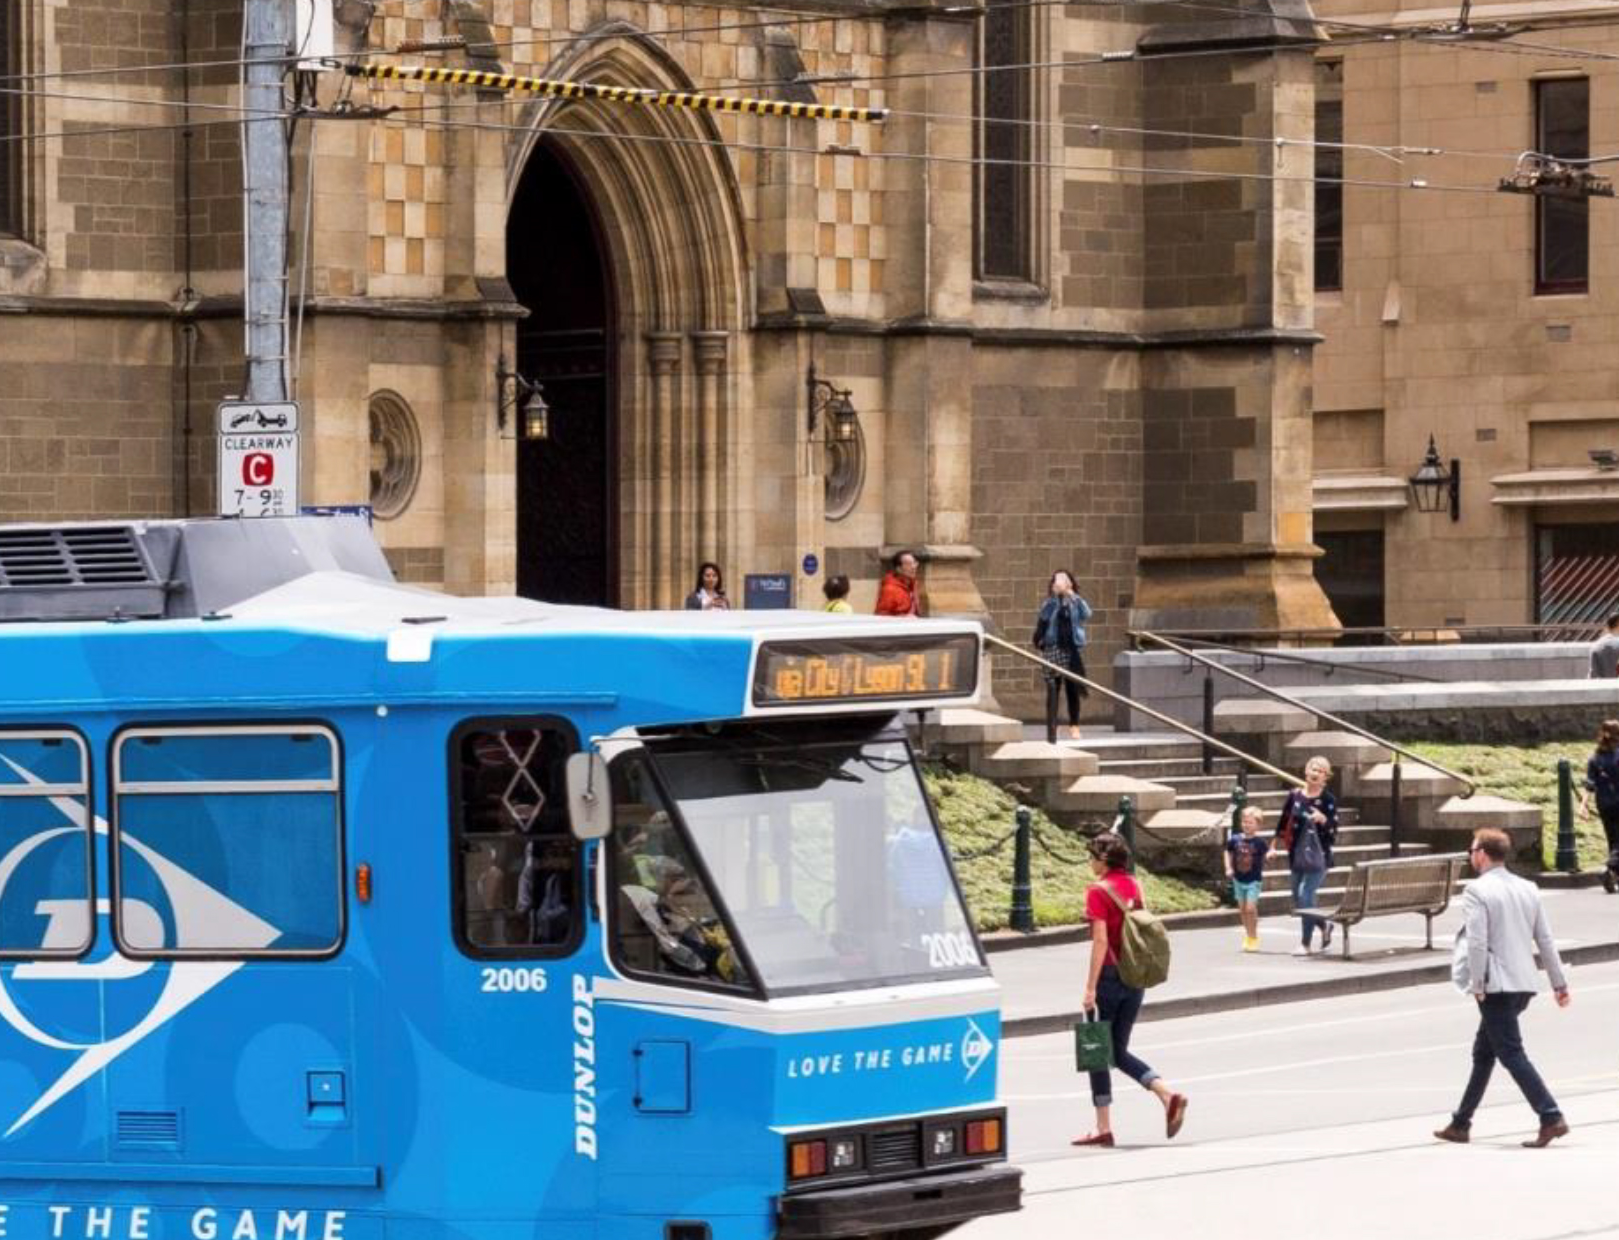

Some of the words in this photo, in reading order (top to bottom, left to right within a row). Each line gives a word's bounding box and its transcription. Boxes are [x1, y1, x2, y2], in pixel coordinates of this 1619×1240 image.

[225, 438, 293, 450] CLEARWAY
[249, 454, 267, 484] C
[481, 967, 548, 993] 2006
[572, 973, 600, 1162] DUNLOP
[788, 1054, 842, 1078] LOVE
[854, 1049, 892, 1071] THE
[901, 1042, 953, 1066] GAME
[48, 1206, 152, 1240] THE
